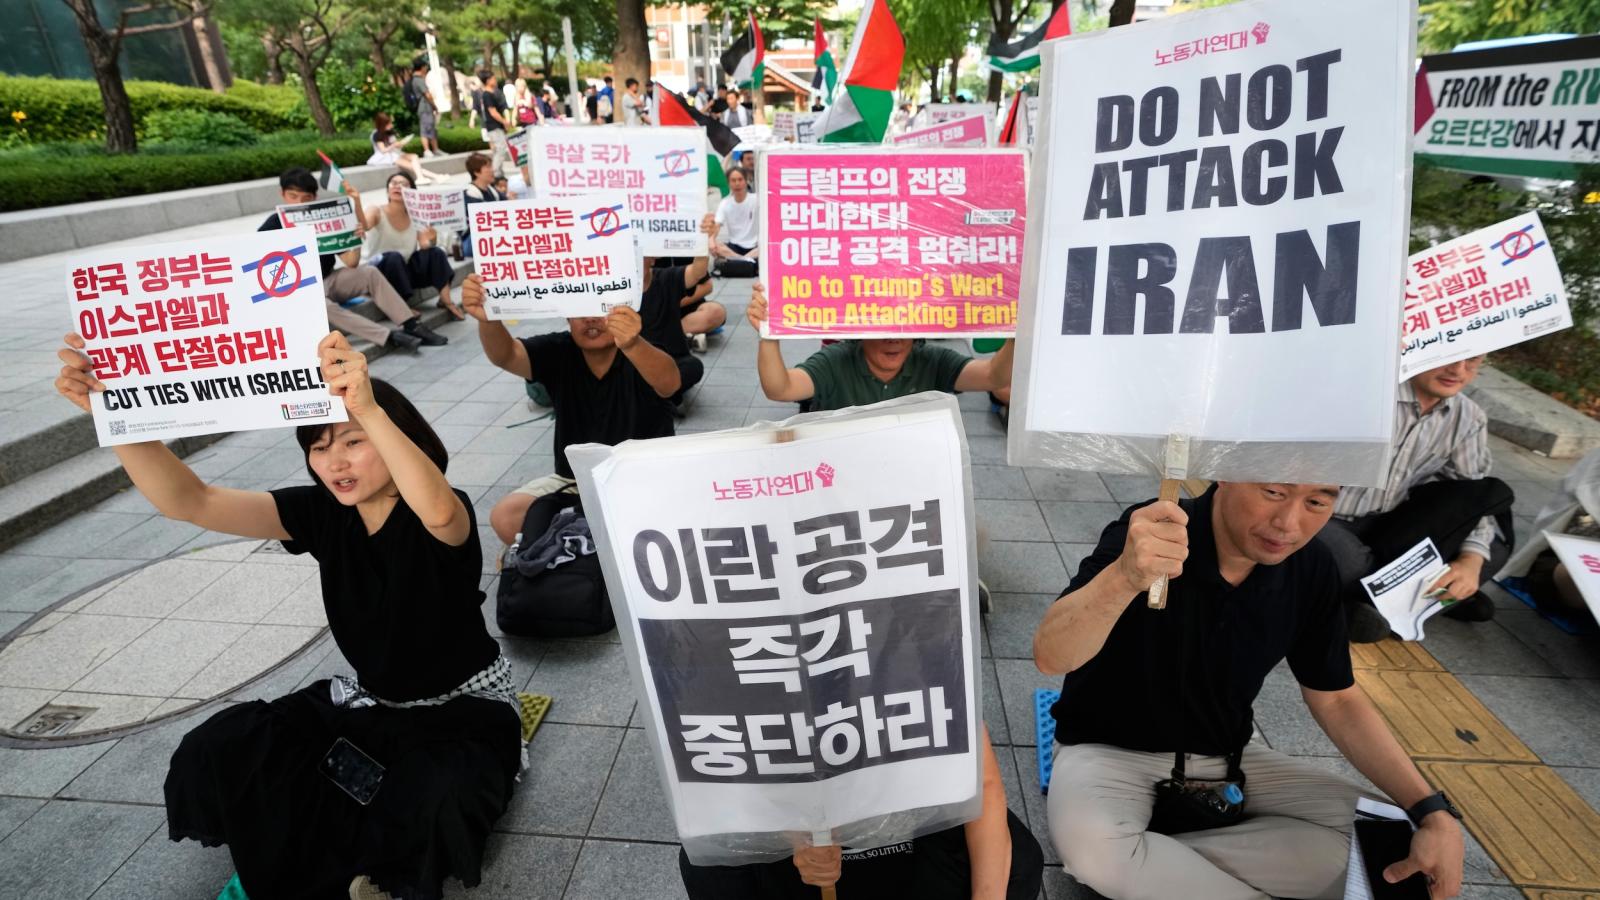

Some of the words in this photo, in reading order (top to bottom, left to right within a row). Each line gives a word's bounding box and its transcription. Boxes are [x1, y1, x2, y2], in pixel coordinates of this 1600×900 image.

[1154, 31, 1248, 66] 노동자연대
[1095, 86, 1179, 153] DO
[1198, 48, 1342, 137] NOT
[1436, 74, 1503, 108] FROM
[1503, 73, 1550, 106] the
[1427, 119, 1566, 149] 요르단강에서
[545, 144, 585, 164] 학살
[591, 144, 631, 164] 국가
[548, 168, 645, 189] 이스라엘과
[779, 167, 898, 196] 트럼프의
[908, 167, 967, 196] 전쟁
[1083, 126, 1345, 220] ATTACK
[628, 193, 677, 213] 하라!
[476, 209, 510, 233] 한국
[515, 207, 574, 230] 정부는
[648, 219, 696, 233] ISRAEL!
[478, 232, 573, 257] 이스라엘과
[780, 237, 842, 266] 이란
[849, 236, 909, 266] 공격
[918, 235, 1017, 265] 멈춰라!
[480, 260, 519, 283] 관계
[523, 256, 611, 280] 단절하라!
[1413, 243, 1485, 278] 정부는
[72, 262, 129, 301] 한국
[136, 252, 233, 293] 정부는
[551, 281, 589, 295] العلاقة
[592, 278, 632, 295] اقطعوا
[782, 275, 811, 298] No
[819, 276, 844, 297] to
[950, 272, 1004, 297] War!
[1061, 220, 1360, 336] IRAN
[1404, 266, 1488, 311] 스라엘과
[534, 288, 549, 299] مع
[1402, 310, 1431, 337] 계
[1435, 277, 1532, 325] 단절하라!
[1513, 293, 1558, 319] اقطعوا
[79, 293, 230, 341] 이스라엘과
[782, 303, 837, 329] Stop
[845, 302, 957, 329] Attacking
[964, 300, 1018, 325] Iran!
[1446, 328, 1463, 343] مع
[86, 344, 151, 380] 관계
[153, 327, 288, 373] 단절하라!
[102, 387, 142, 411] CUT
[143, 381, 189, 406] TIES
[191, 376, 242, 401] WITH
[246, 366, 326, 396] ISRAEL!
[712, 470, 814, 501] 노동자연대
[632, 523, 780, 604] 이란
[793, 498, 945, 595] 공격
[728, 608, 872, 693] 즉각
[680, 686, 953, 777] 중단하라
[866, 849, 879, 858] SO
[879, 844, 907, 856] LITTLE
